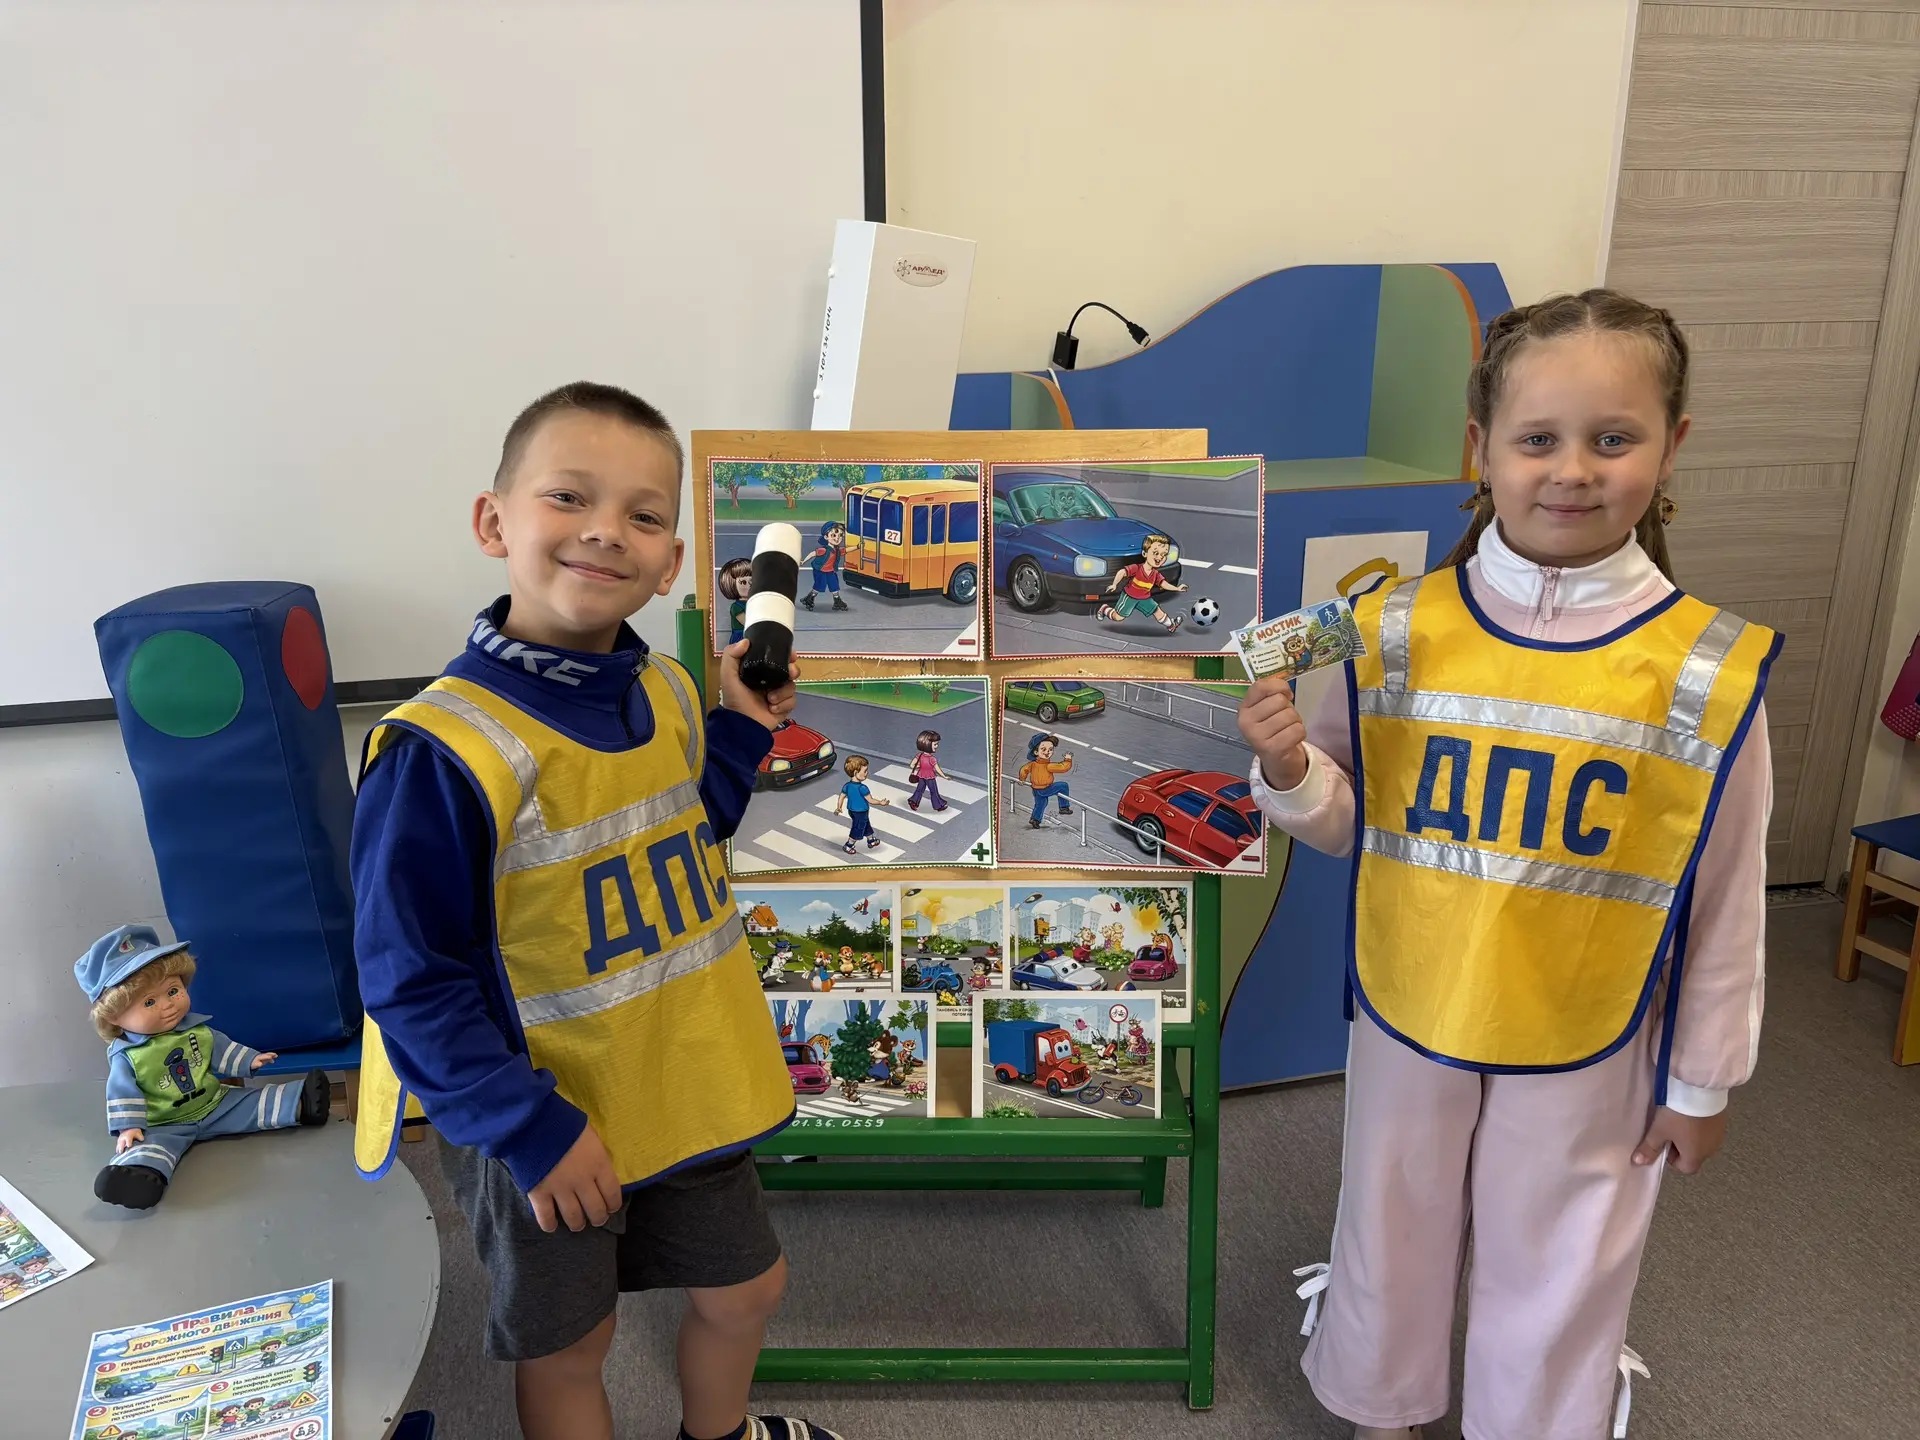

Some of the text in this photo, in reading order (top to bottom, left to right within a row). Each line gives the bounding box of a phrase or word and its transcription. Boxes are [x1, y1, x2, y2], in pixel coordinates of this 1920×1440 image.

[887, 531, 899, 541] 27
[1256, 615, 1302, 641] МОСТИК
[1405, 735, 1629, 857] ДПС
[583, 820, 728, 976] ДПС
[842, 1118, 885, 1128] 0559
[132, 1310, 282, 1351] ДОРОЖНОГО ДВИЖЕНИЯ
[171, 1306, 255, 1332] Правила
